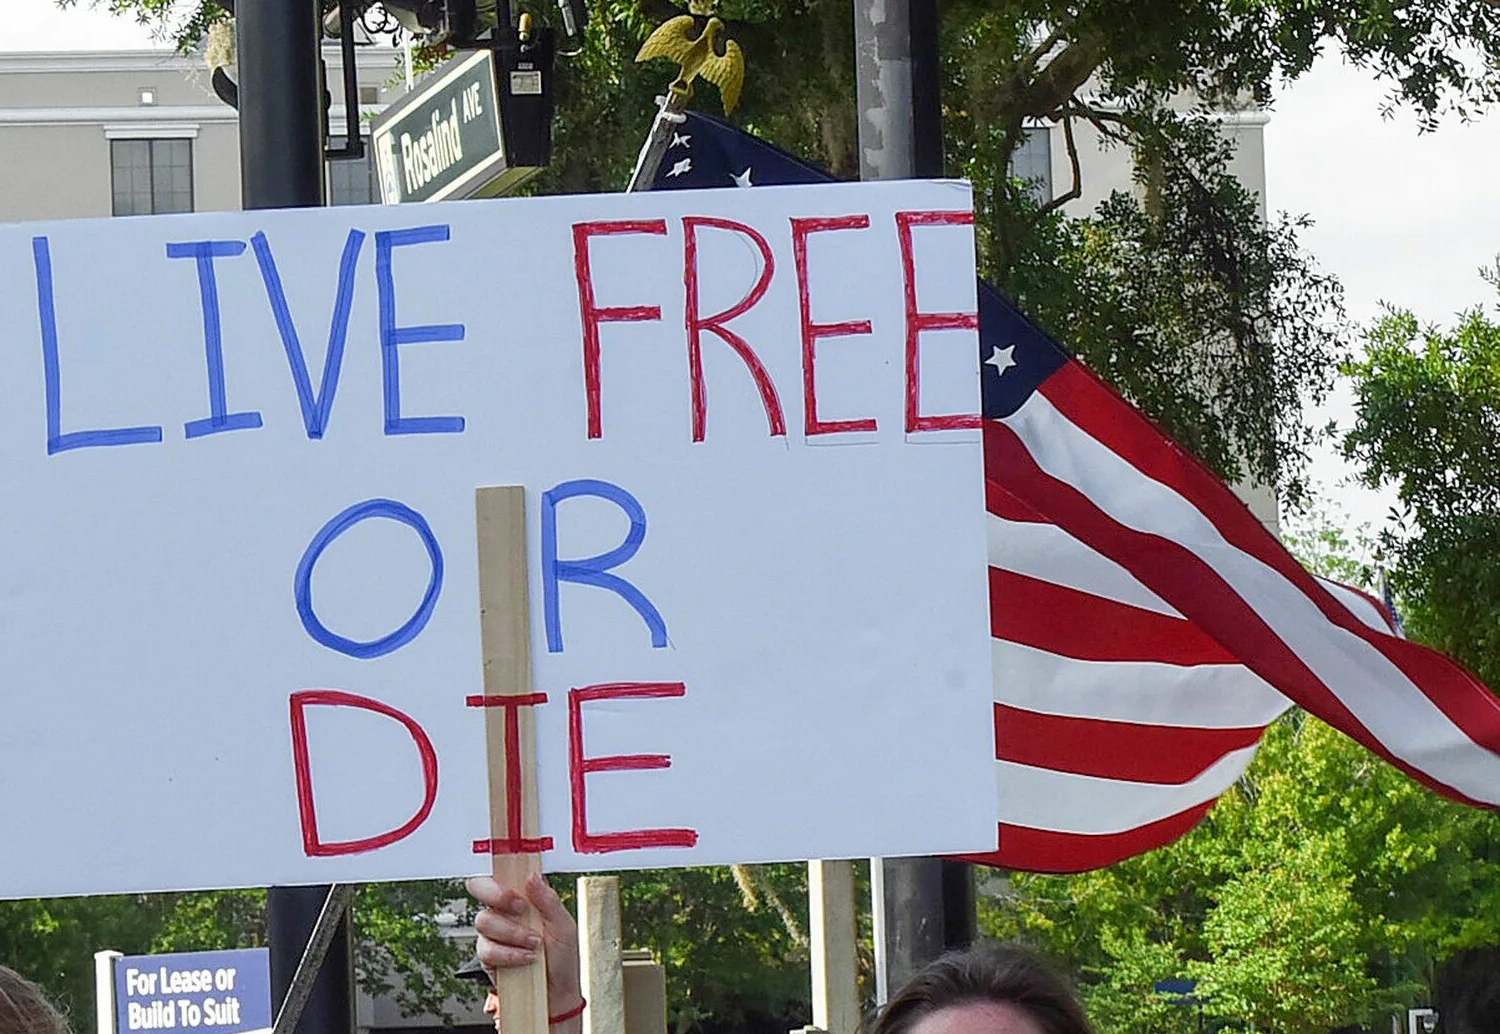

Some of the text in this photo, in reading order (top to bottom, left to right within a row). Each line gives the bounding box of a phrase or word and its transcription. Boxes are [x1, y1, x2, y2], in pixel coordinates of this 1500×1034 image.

[401, 81, 483, 195] Rosalind AVE
[33, 211, 983, 455] LIVE FREE
[294, 479, 668, 659] OR
[288, 681, 699, 858] DIE
[126, 966, 236, 996] For Lease or
[128, 996, 241, 1030] Build To Suit
